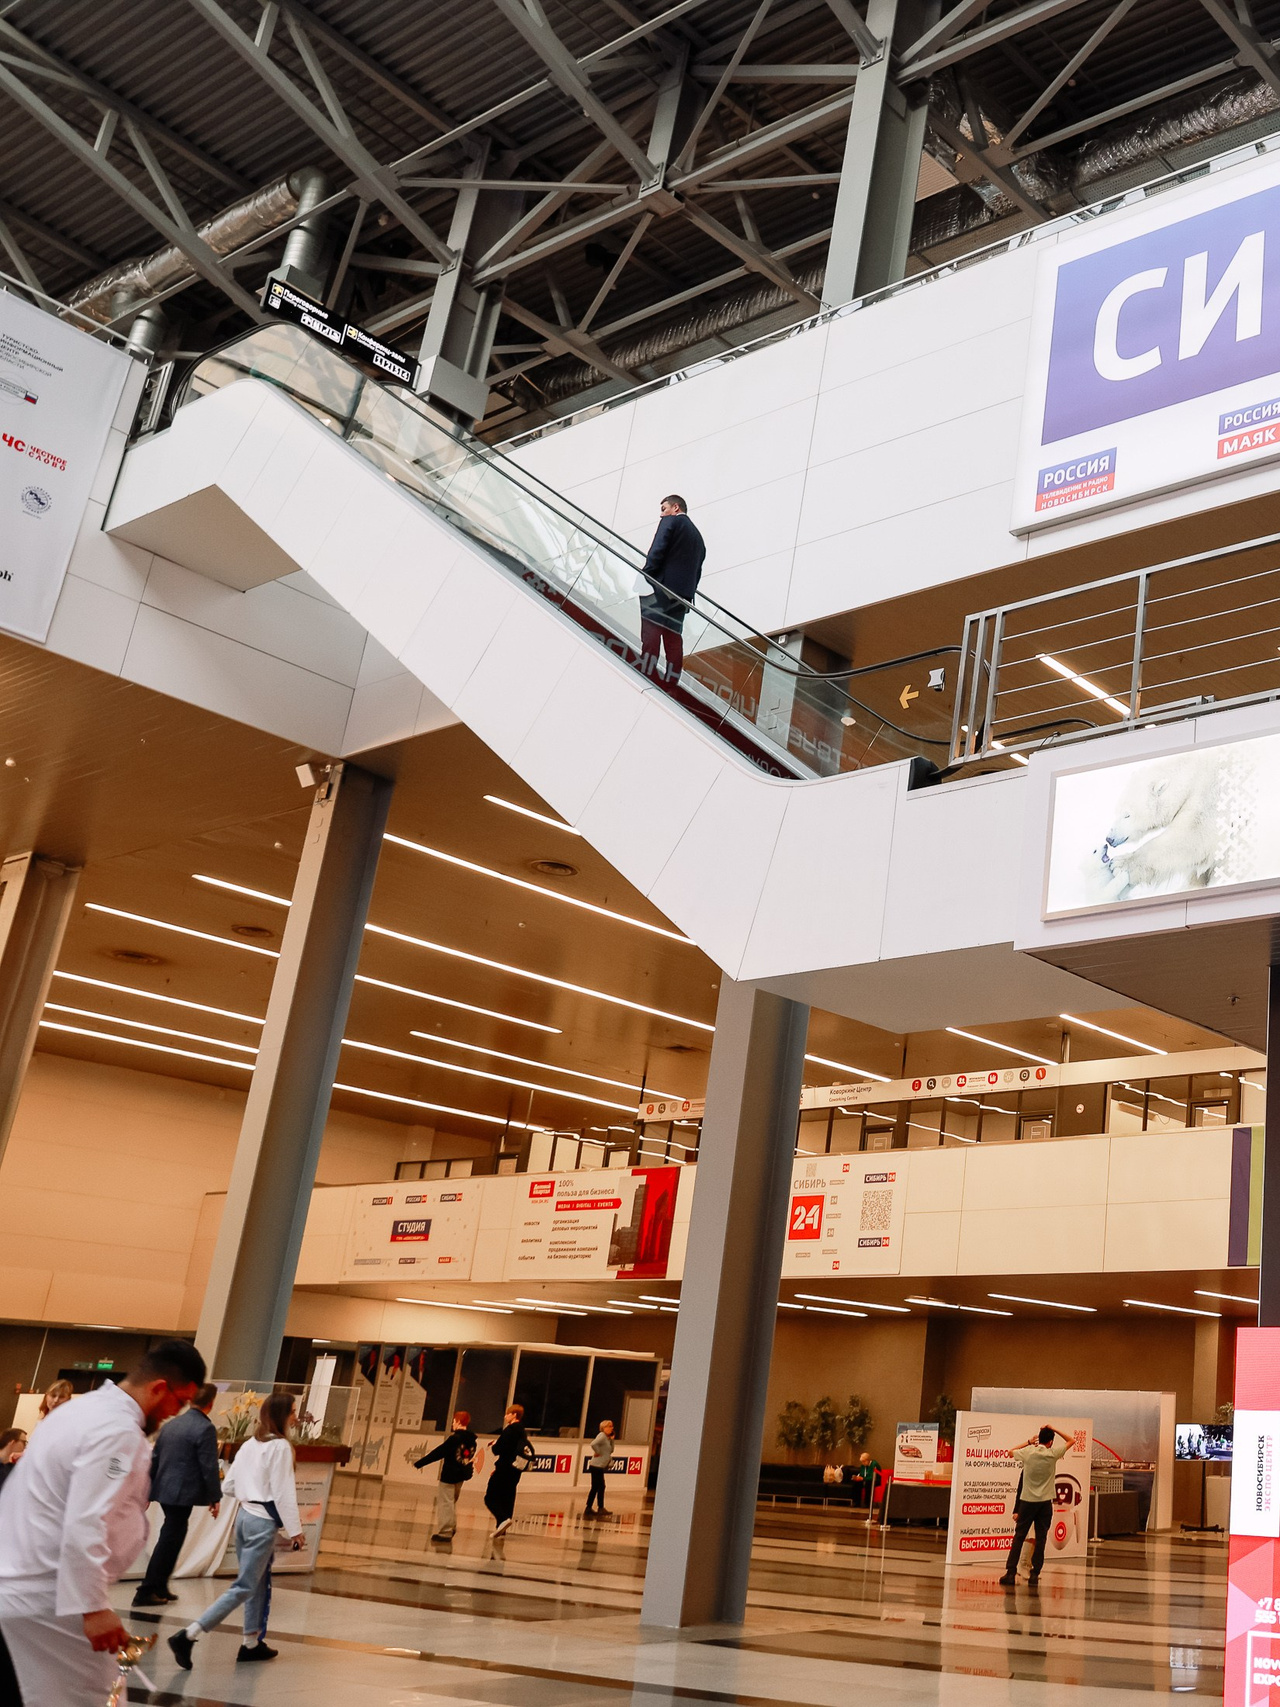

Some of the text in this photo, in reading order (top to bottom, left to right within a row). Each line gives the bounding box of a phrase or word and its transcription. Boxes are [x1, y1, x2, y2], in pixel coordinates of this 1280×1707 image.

[2, 433, 26, 452] ЧС
[1222, 427, 1277, 455] МАЯК
[28, 452, 66, 471] СЛОВО
[30, 445, 67, 466] ЧЕСТНОЕ
[1043, 455, 1110, 489] РОССИЯ
[1042, 483, 1082, 500] ТЕЛЕВИДЕНИЕ
[1087, 476, 1108, 487] РАДИО
[1041, 484, 1108, 510] НОВОСИБИРСК
[793, 1179, 827, 1189] СИБИРЬ
[866, 1174, 887, 1182] СИБИРЬ
[792, 1205, 820, 1231] 24
[398, 1221, 426, 1233] СТУДИЯ
[966, 1448, 1014, 1459] ВАШ ЦИФРО
[630, 1461, 641, 1471] 24
[1256, 1435, 1265, 1512] НОВОСИБИРСК
[968, 1505, 988, 1513] ОДНОМ
[960, 1527, 980, 1535] НАЙДИТЕ
[961, 1539, 996, 1549] БЫСТРО И
[1258, 1597, 1273, 1610] +7
